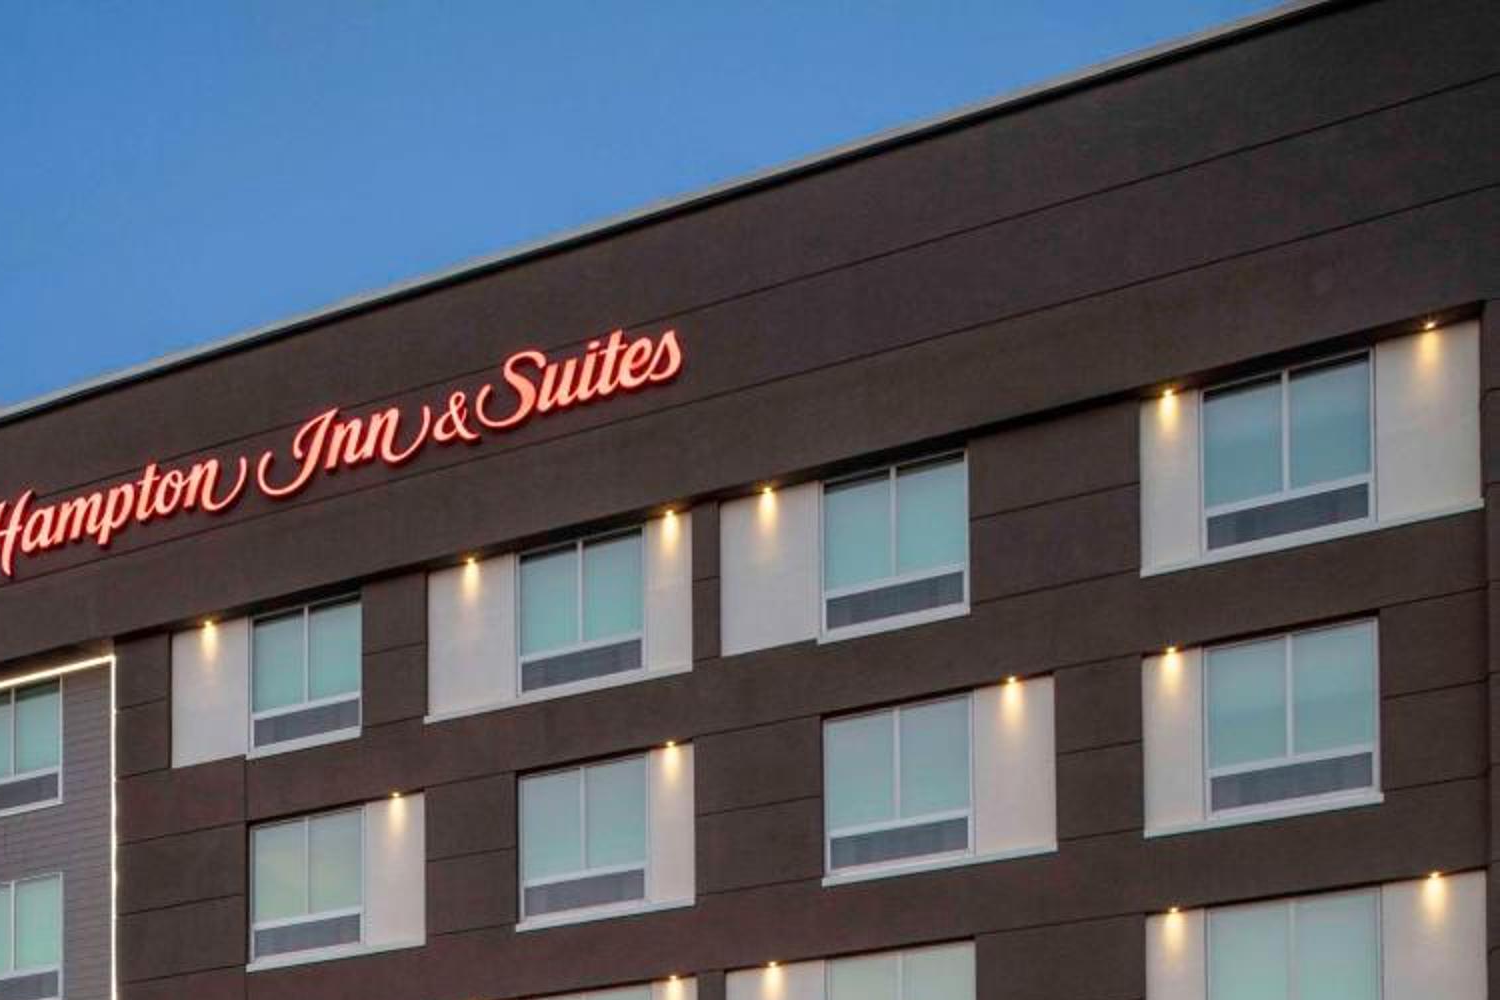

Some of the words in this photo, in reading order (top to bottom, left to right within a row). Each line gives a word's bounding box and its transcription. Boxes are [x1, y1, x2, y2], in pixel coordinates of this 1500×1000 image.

[257, 407, 431, 497] Inn
[433, 390, 481, 441] &
[475, 328, 684, 429] Suites
